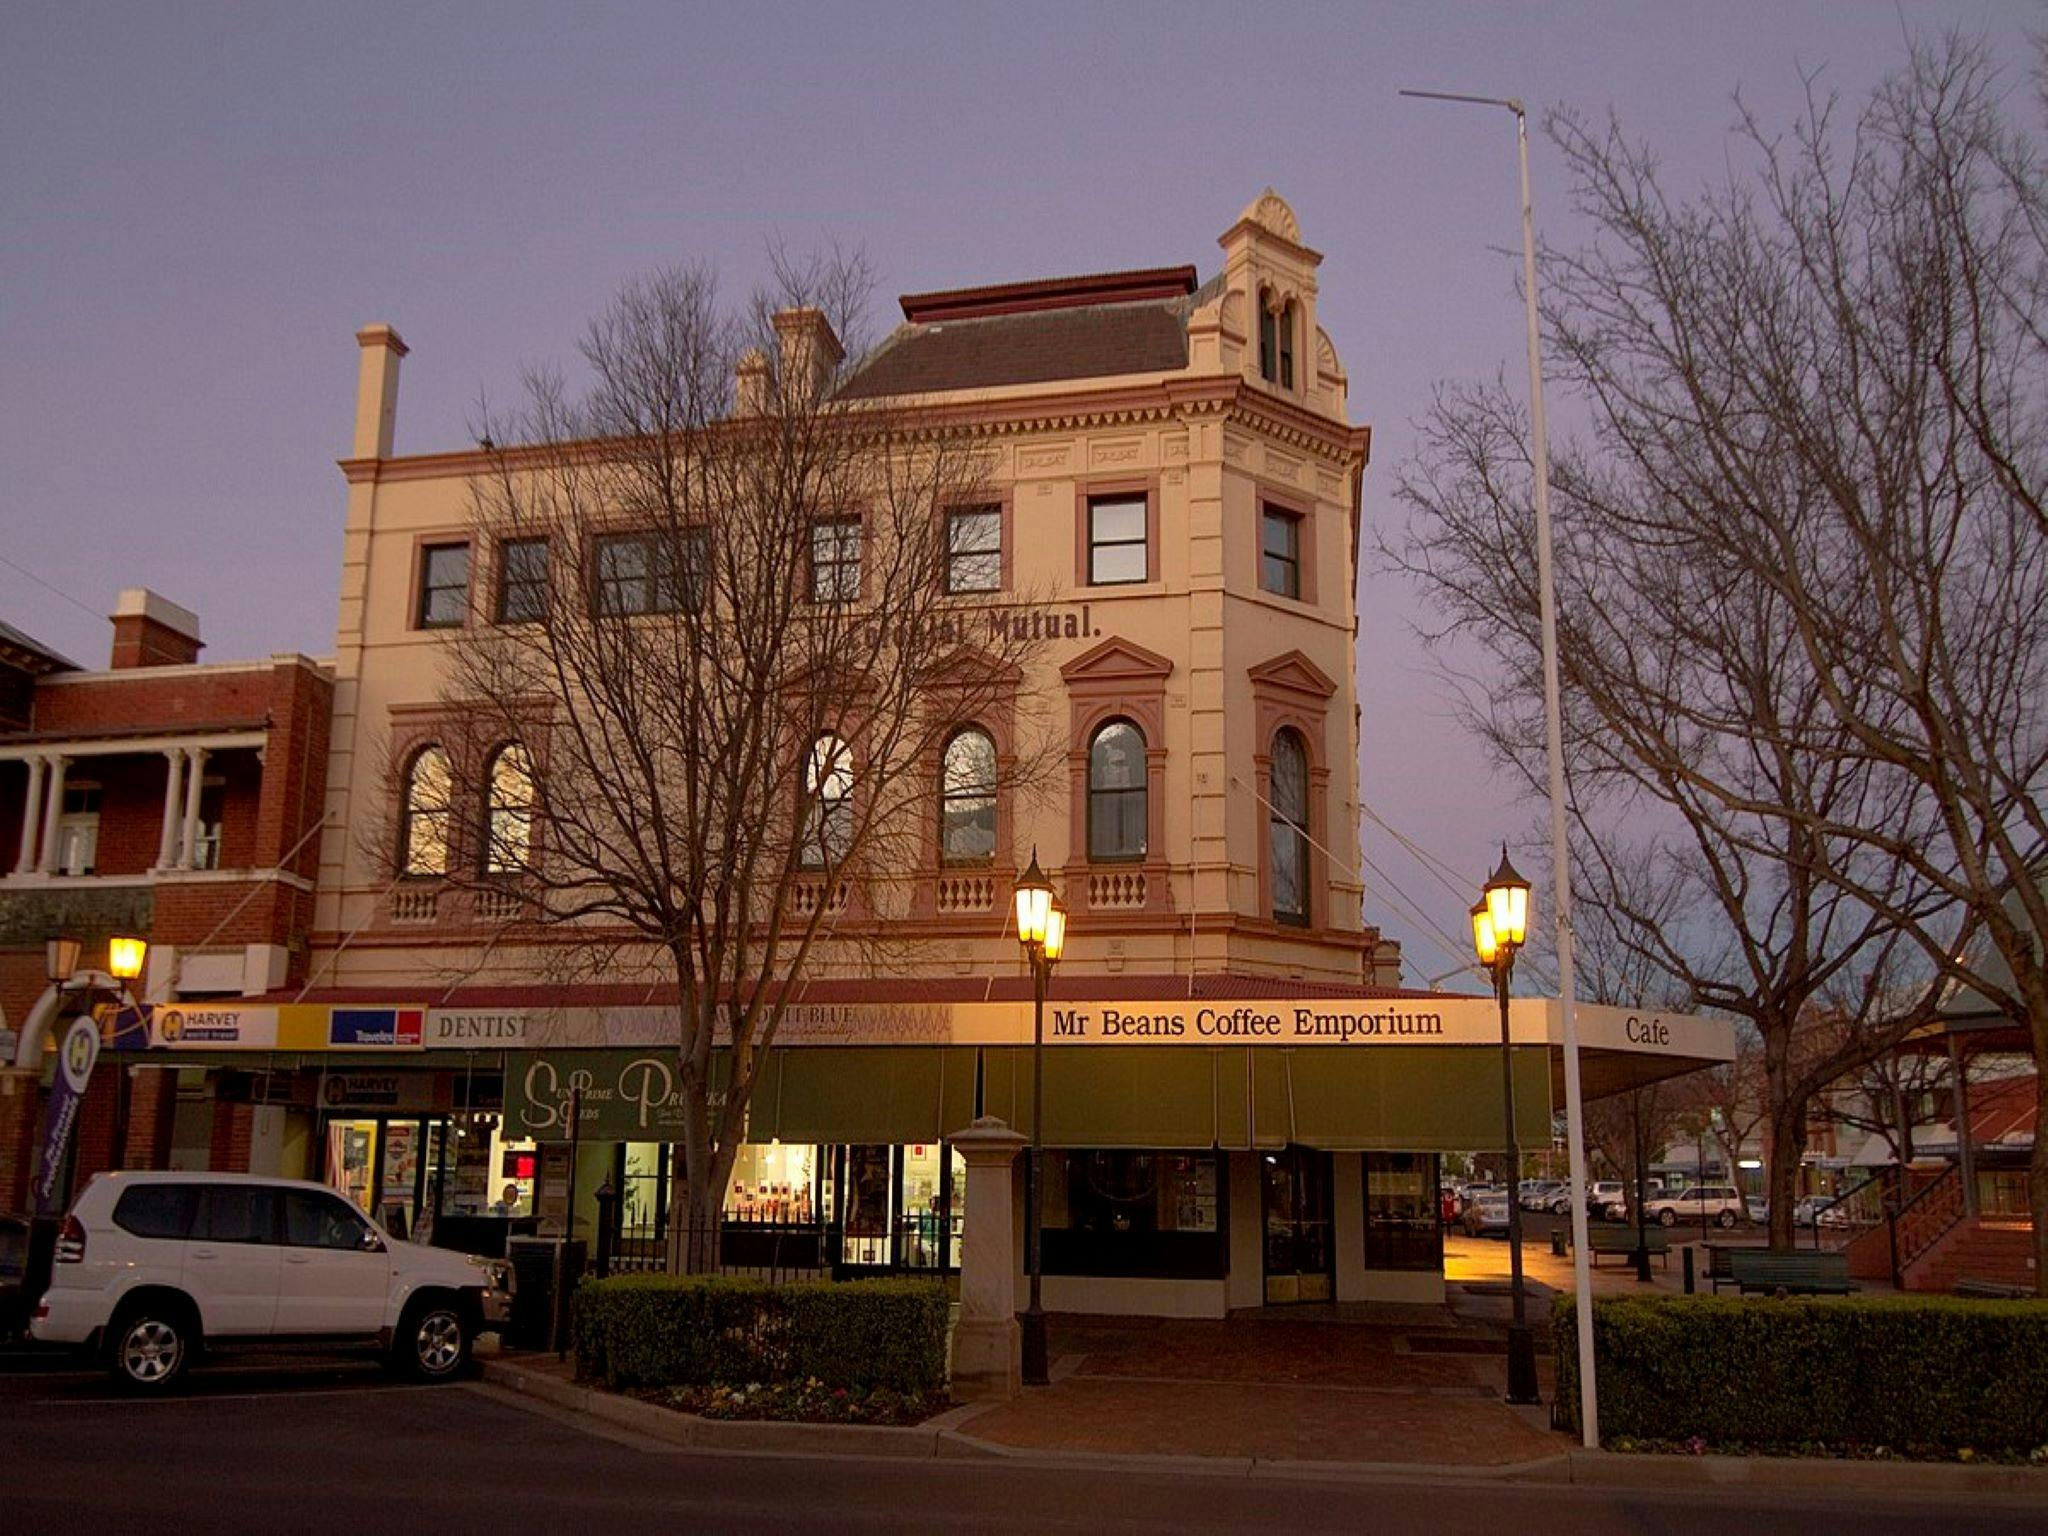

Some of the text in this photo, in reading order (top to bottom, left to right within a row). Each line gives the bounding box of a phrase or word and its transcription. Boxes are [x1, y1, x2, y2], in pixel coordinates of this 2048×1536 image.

[987, 604, 1101, 643] Mutual.
[187, 1012, 240, 1025] HARVEY
[438, 1015, 531, 1038] DENTIST
[1053, 1007, 1443, 1041] Mr Beans Coffee Emporium
[1626, 1016, 1669, 1046] Cafe
